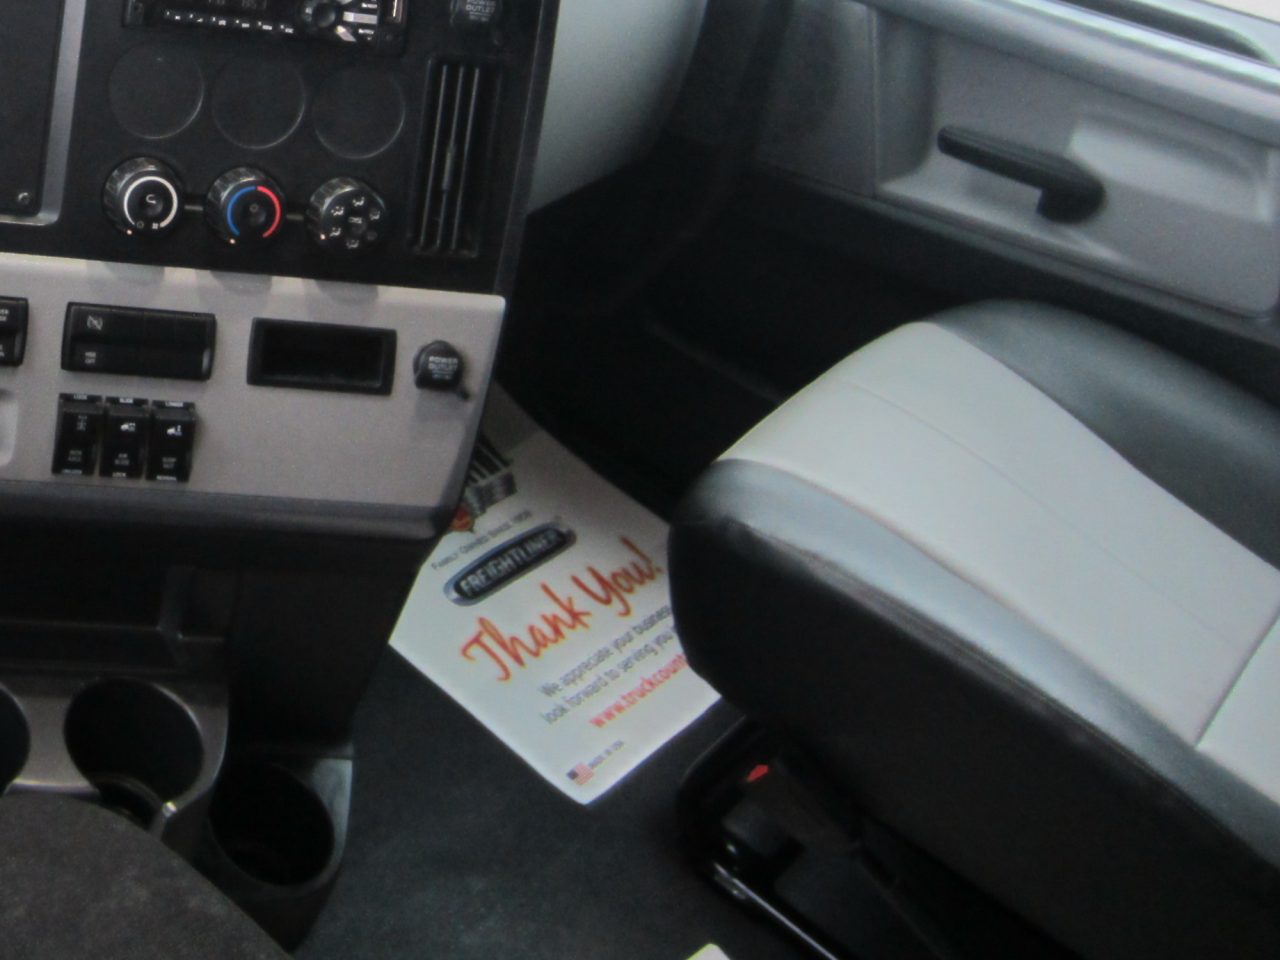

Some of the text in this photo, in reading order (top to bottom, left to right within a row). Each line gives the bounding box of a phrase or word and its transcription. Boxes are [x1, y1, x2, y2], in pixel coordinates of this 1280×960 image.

[460, 527, 559, 596] FREIGHTLINER
[460, 537, 665, 682] Thank You!
[539, 681, 561, 697] We
[560, 646, 614, 686] appreciate
[613, 631, 634, 653] your
[539, 703, 568, 724] look
[562, 675, 608, 707] forward
[603, 668, 620, 681] to
[617, 642, 659, 672] serving
